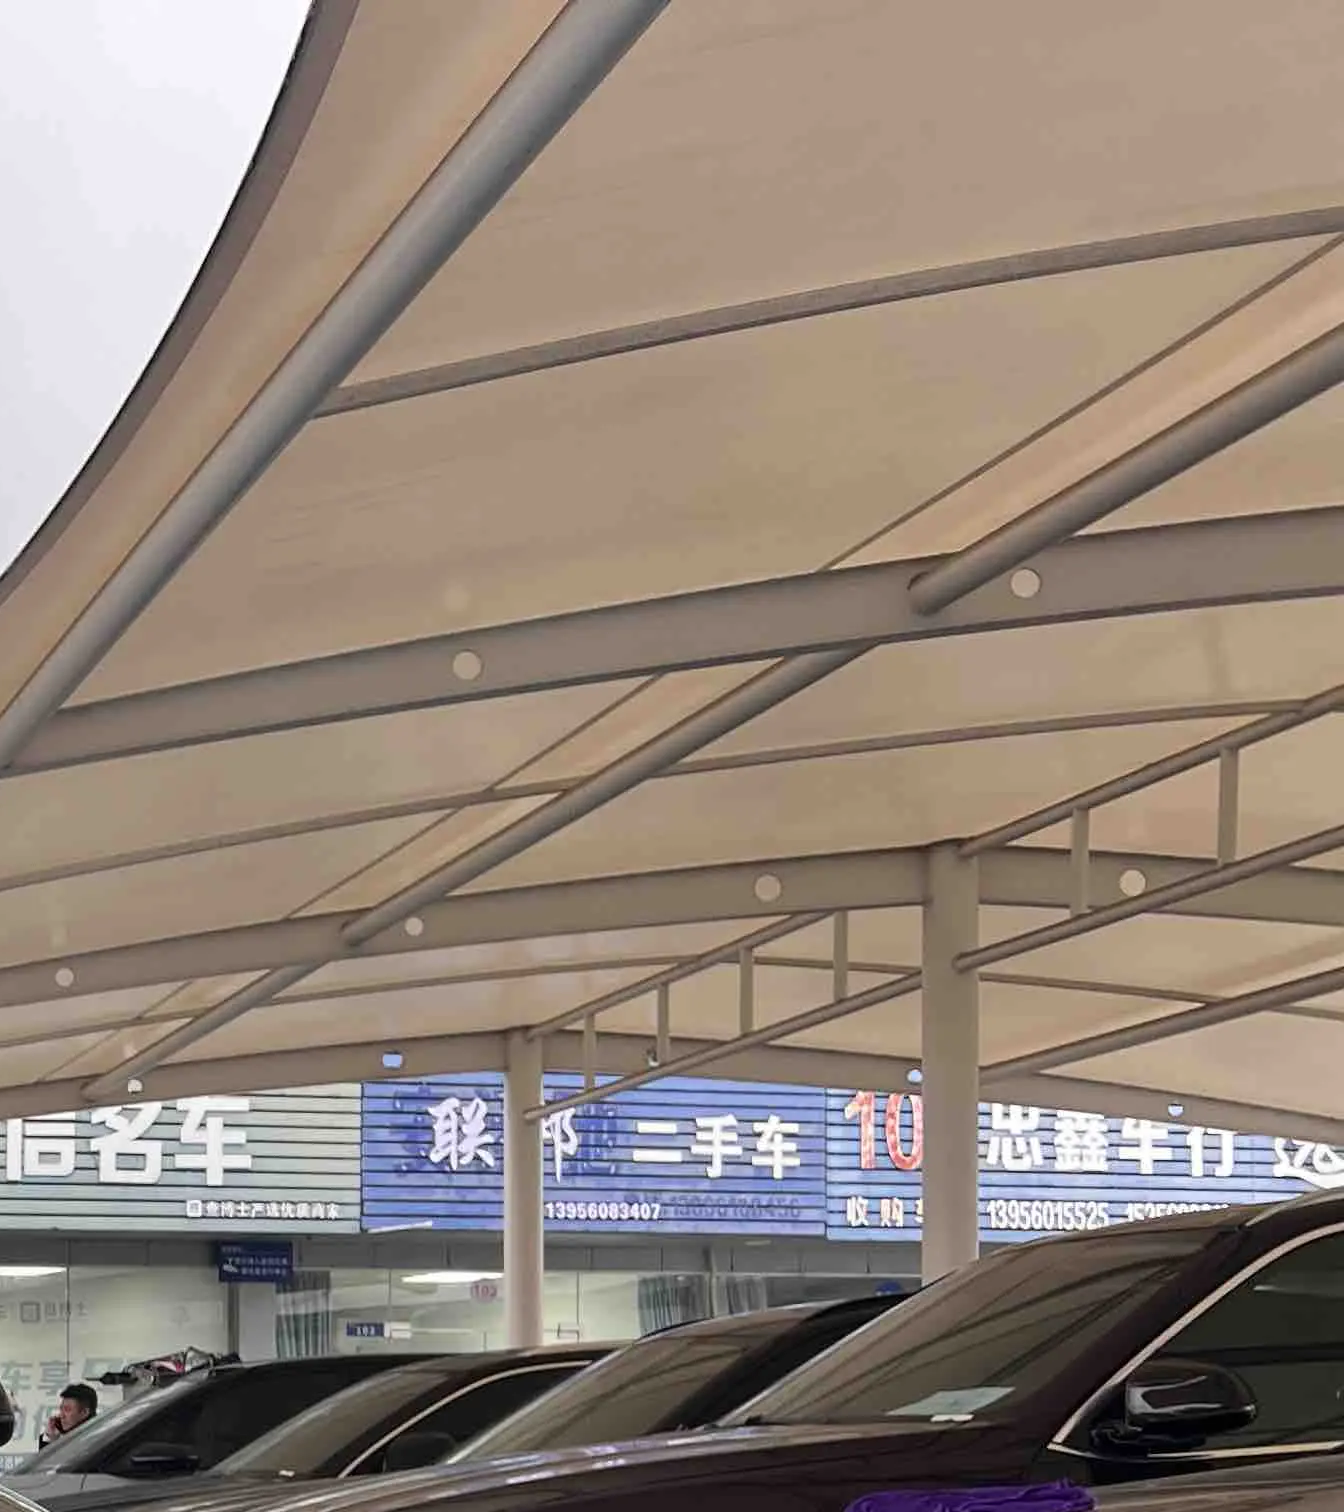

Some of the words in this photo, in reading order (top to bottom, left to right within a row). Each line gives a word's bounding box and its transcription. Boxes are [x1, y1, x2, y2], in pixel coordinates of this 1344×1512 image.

[632, 1114, 801, 1179] 二手车
[545, 1202, 661, 1220] 13956083407
[846, 1197, 924, 1228] 收购
[987, 1200, 1109, 1230] 13956015525
